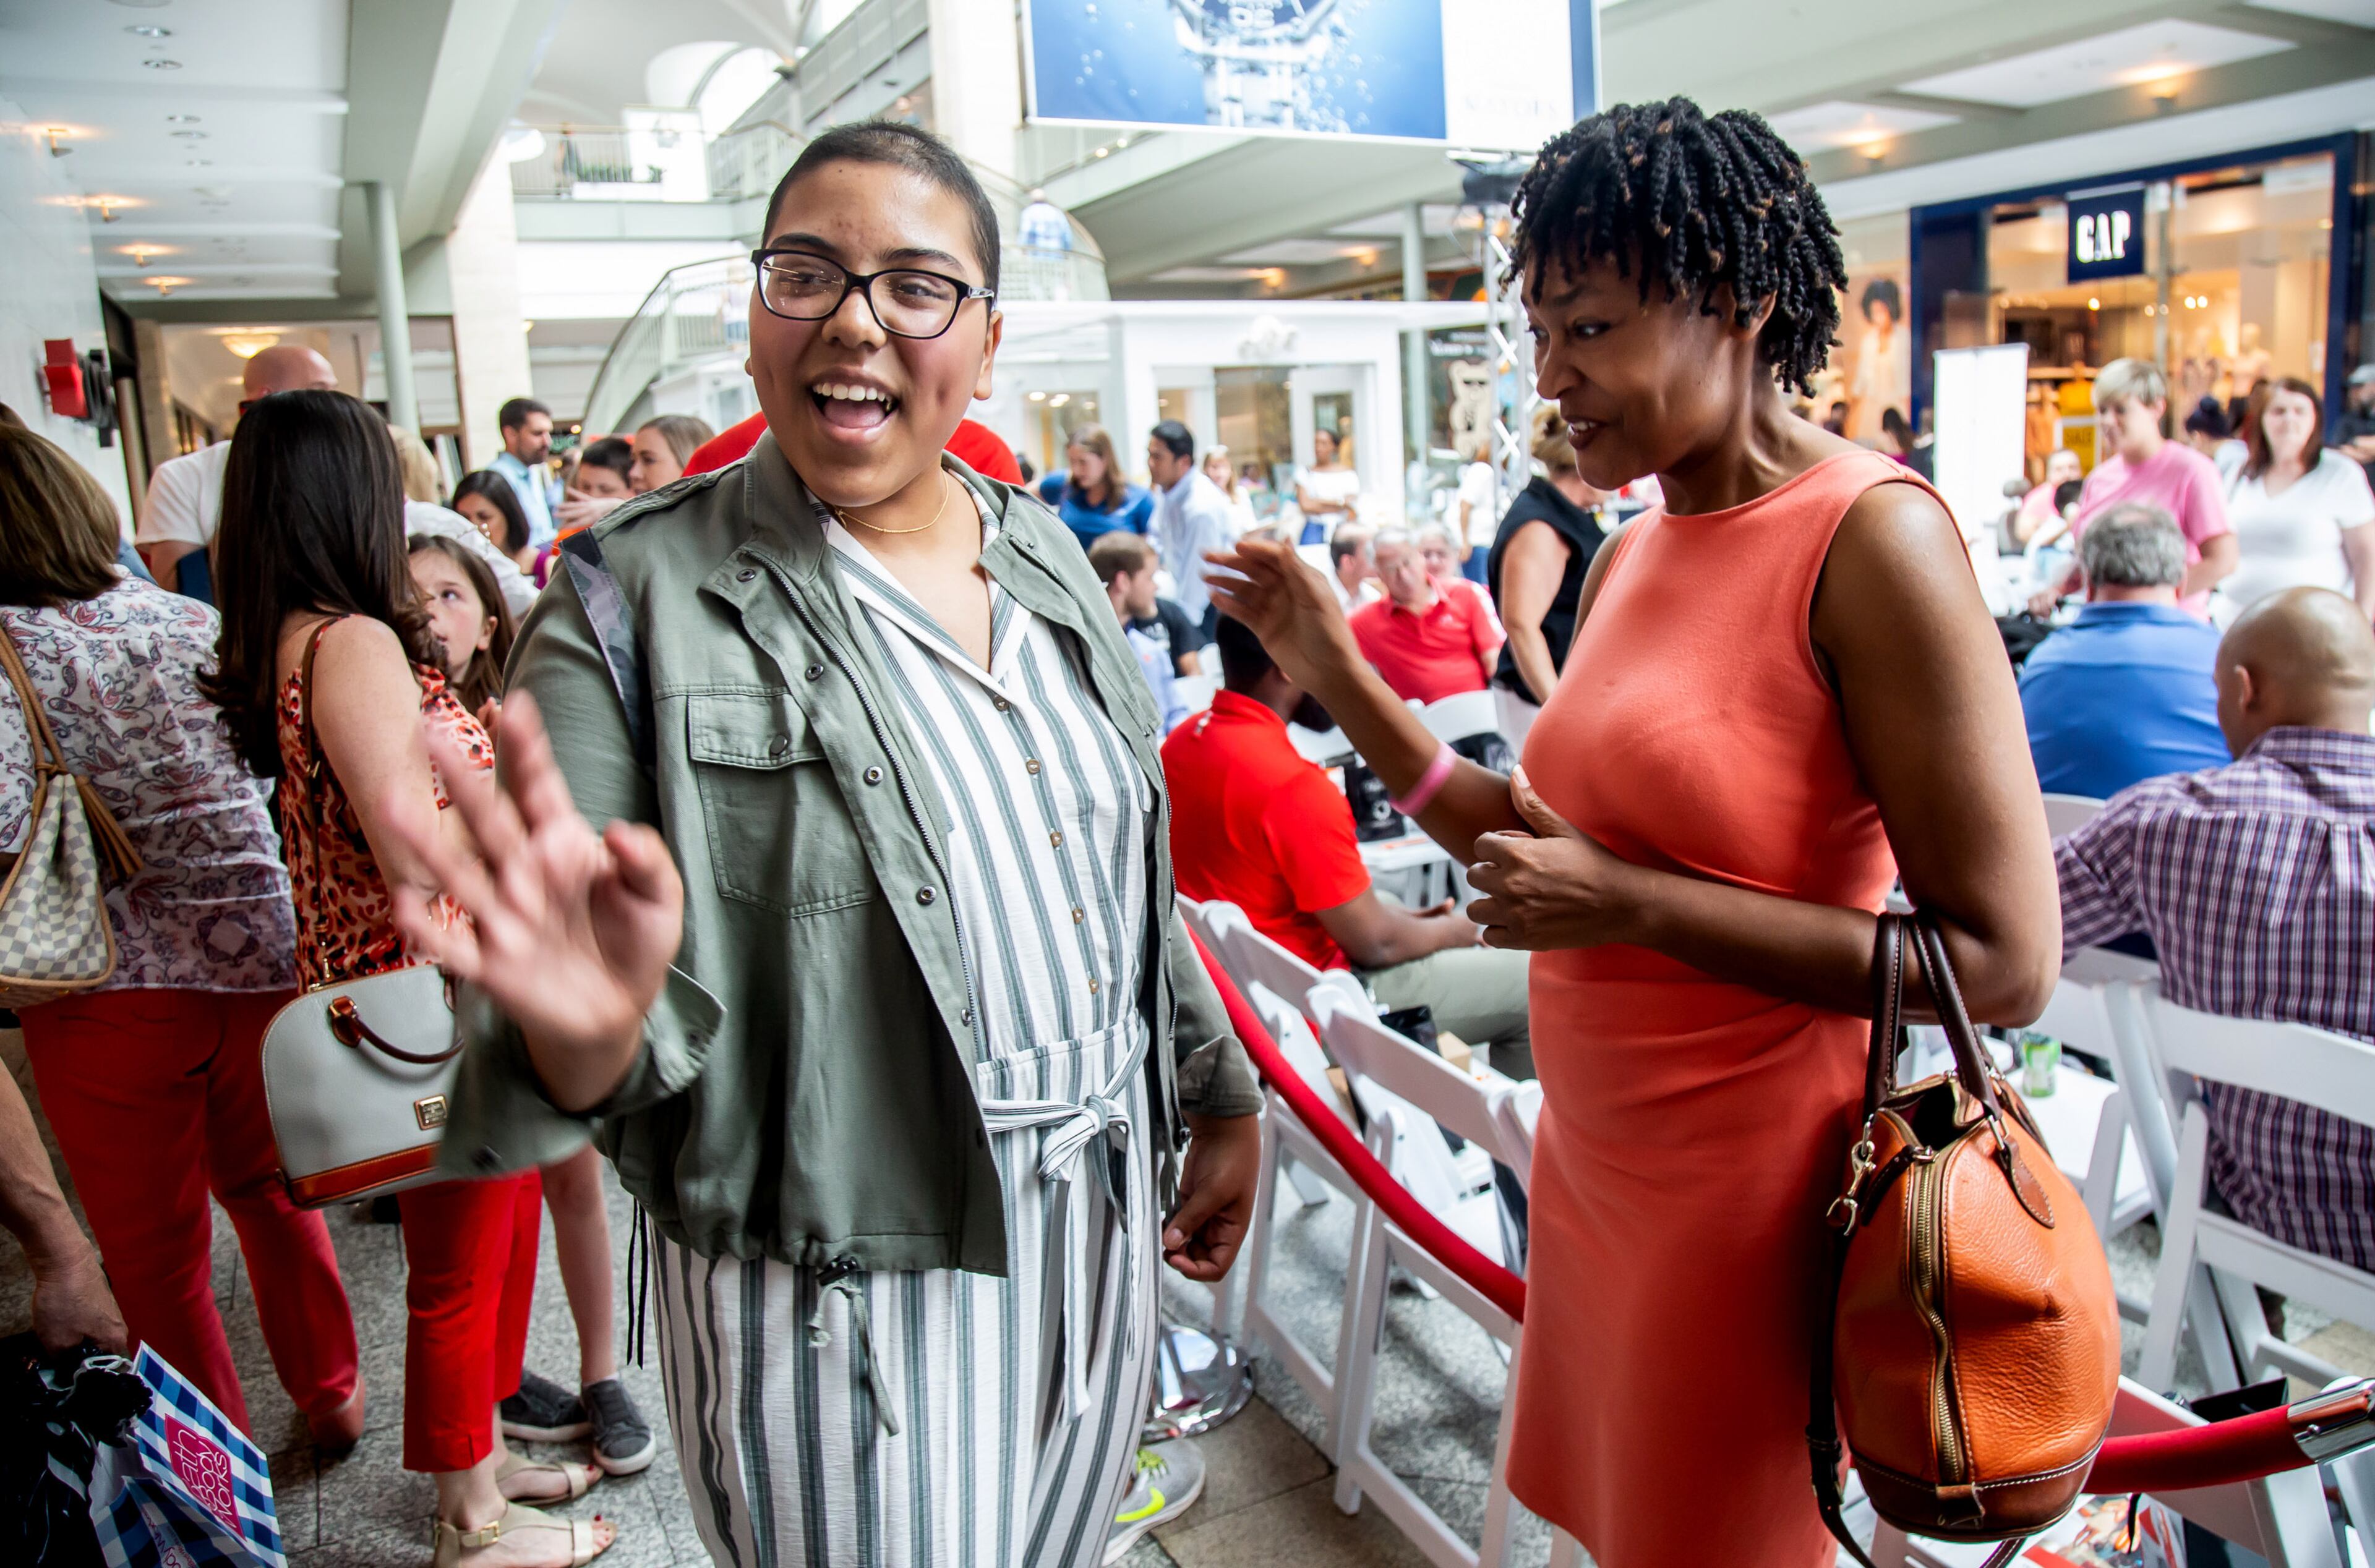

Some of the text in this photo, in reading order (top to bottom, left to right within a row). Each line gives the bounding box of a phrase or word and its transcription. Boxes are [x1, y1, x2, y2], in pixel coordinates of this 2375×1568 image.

[2076, 210, 2131, 263] GAP
[173, 1429, 209, 1505] Bath
[195, 1441, 218, 1511] Body
[214, 1451, 237, 1528] Works
